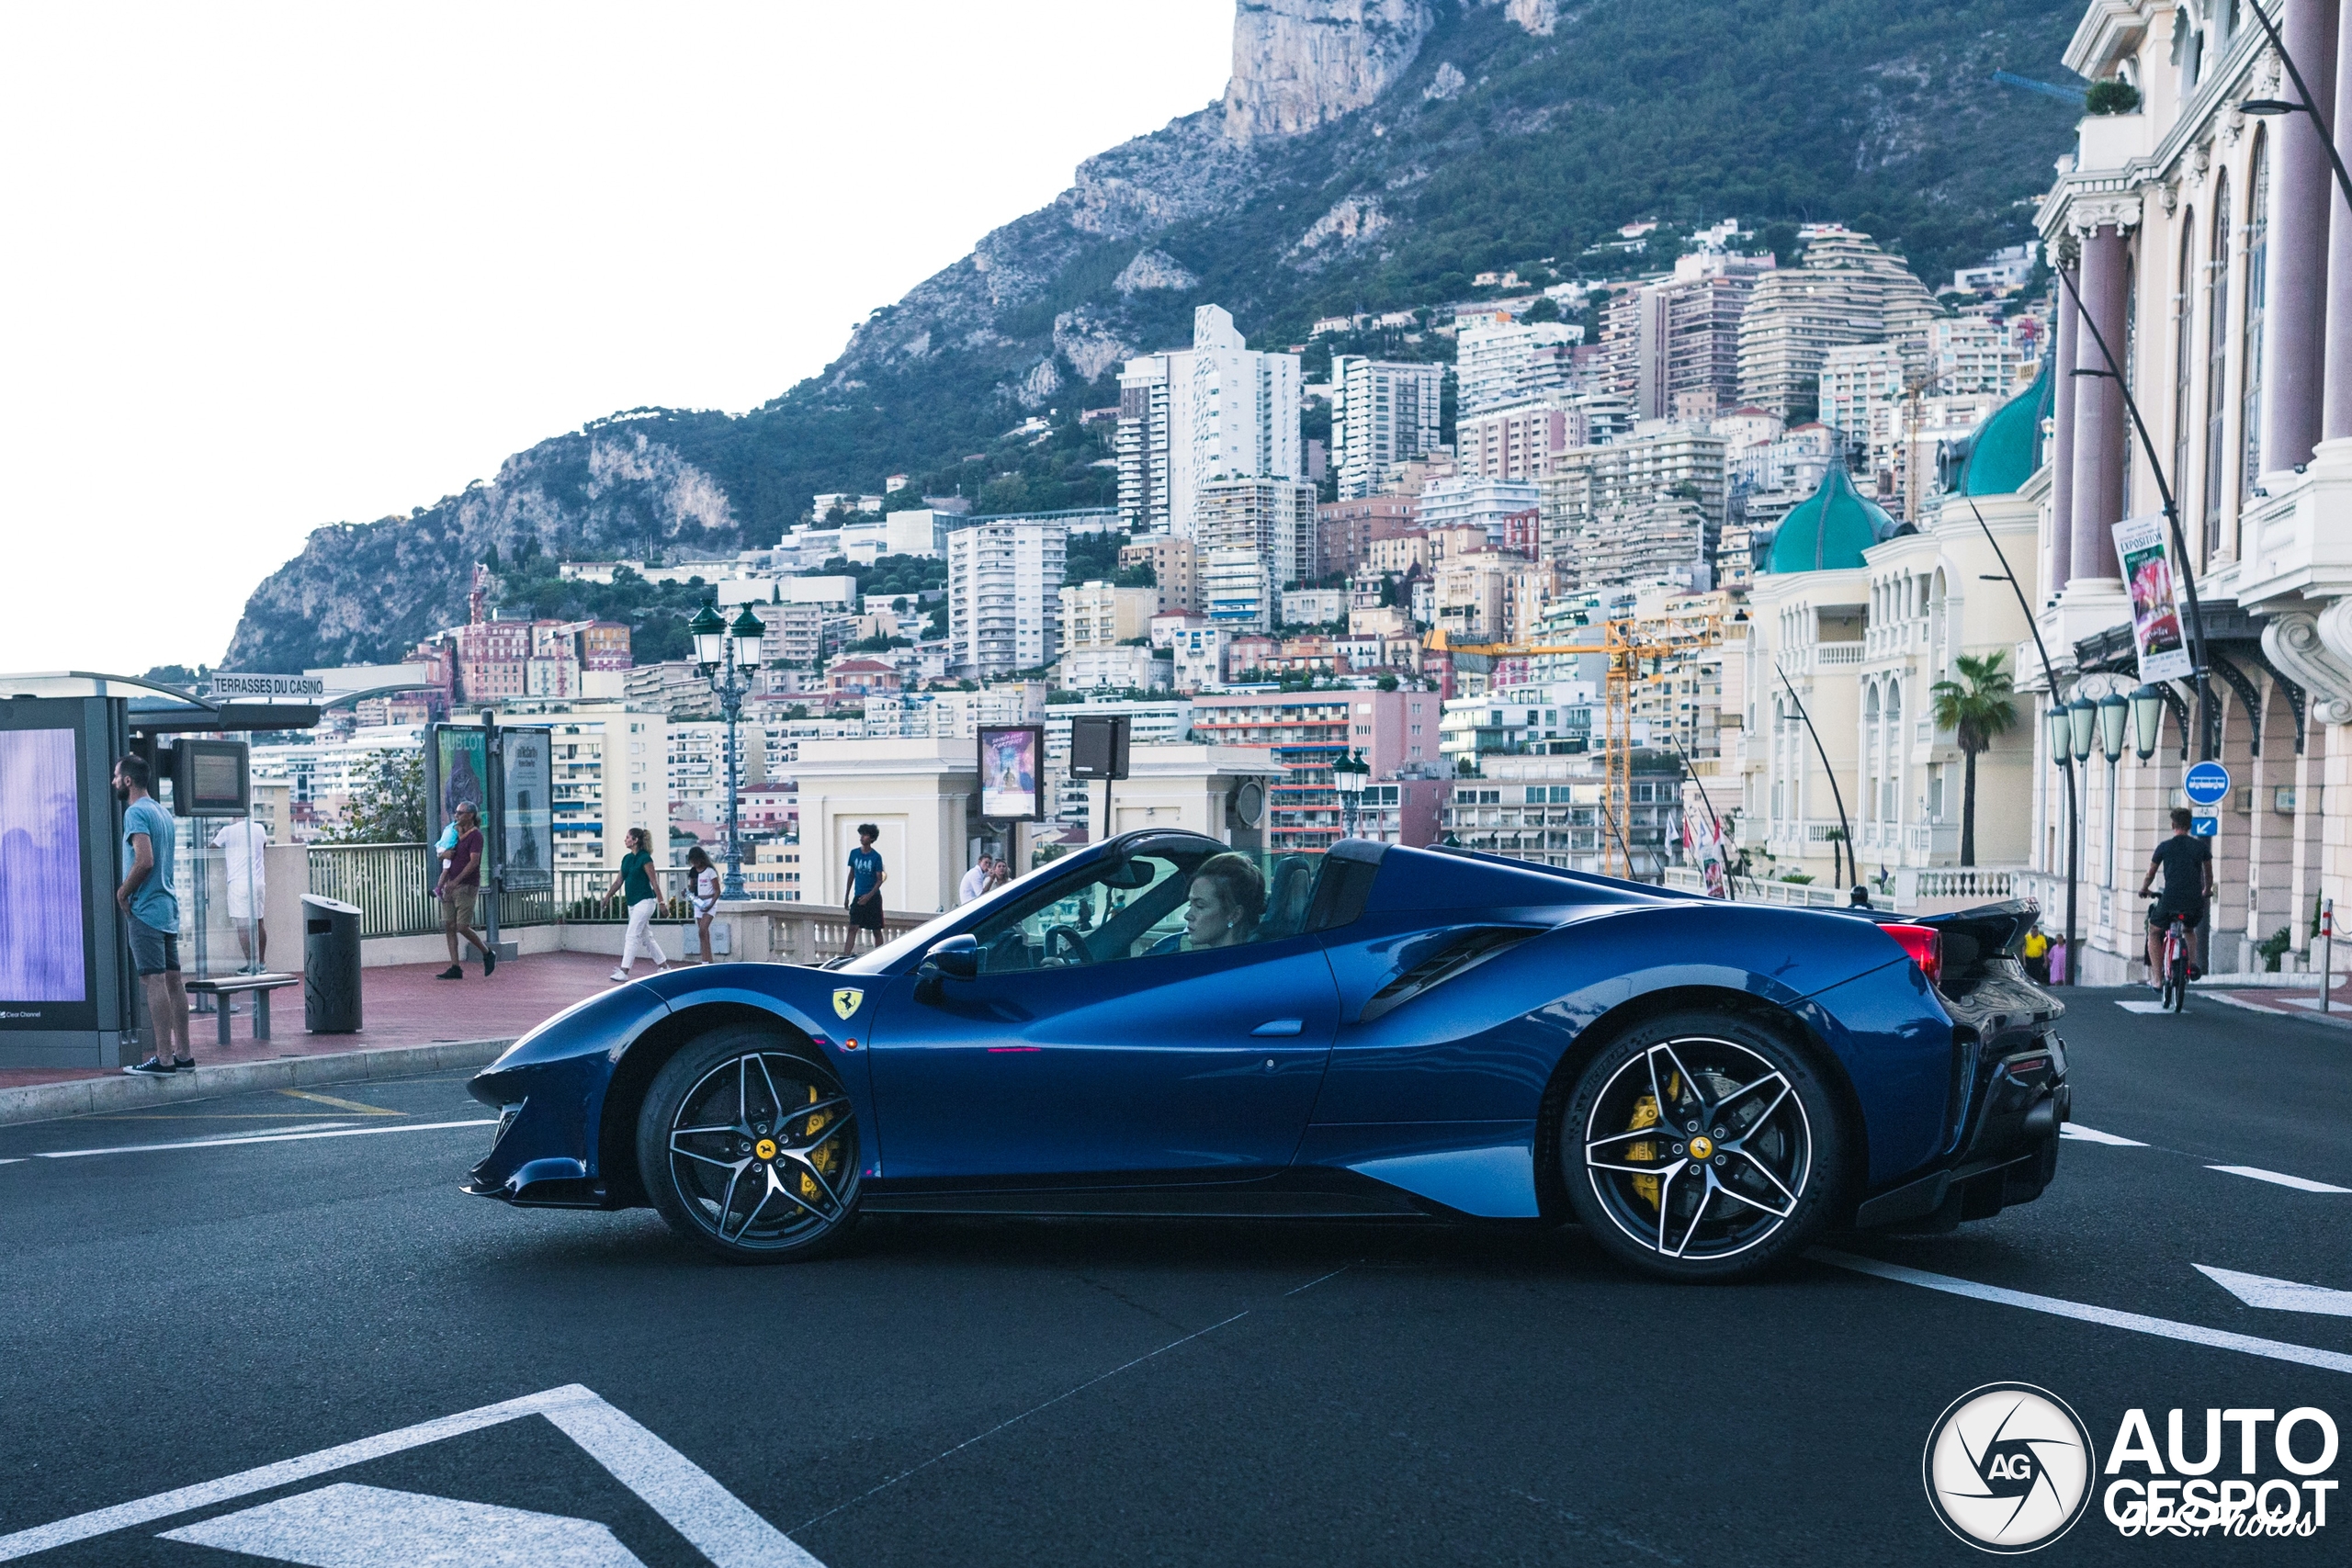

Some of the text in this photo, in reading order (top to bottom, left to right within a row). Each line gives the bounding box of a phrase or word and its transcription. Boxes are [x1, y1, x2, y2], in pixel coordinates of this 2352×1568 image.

[2120, 532, 2162, 552] EXPOSITION
[215, 678, 323, 694] TERRASSES DU CASINO
[439, 732, 484, 751] HUBLOT
